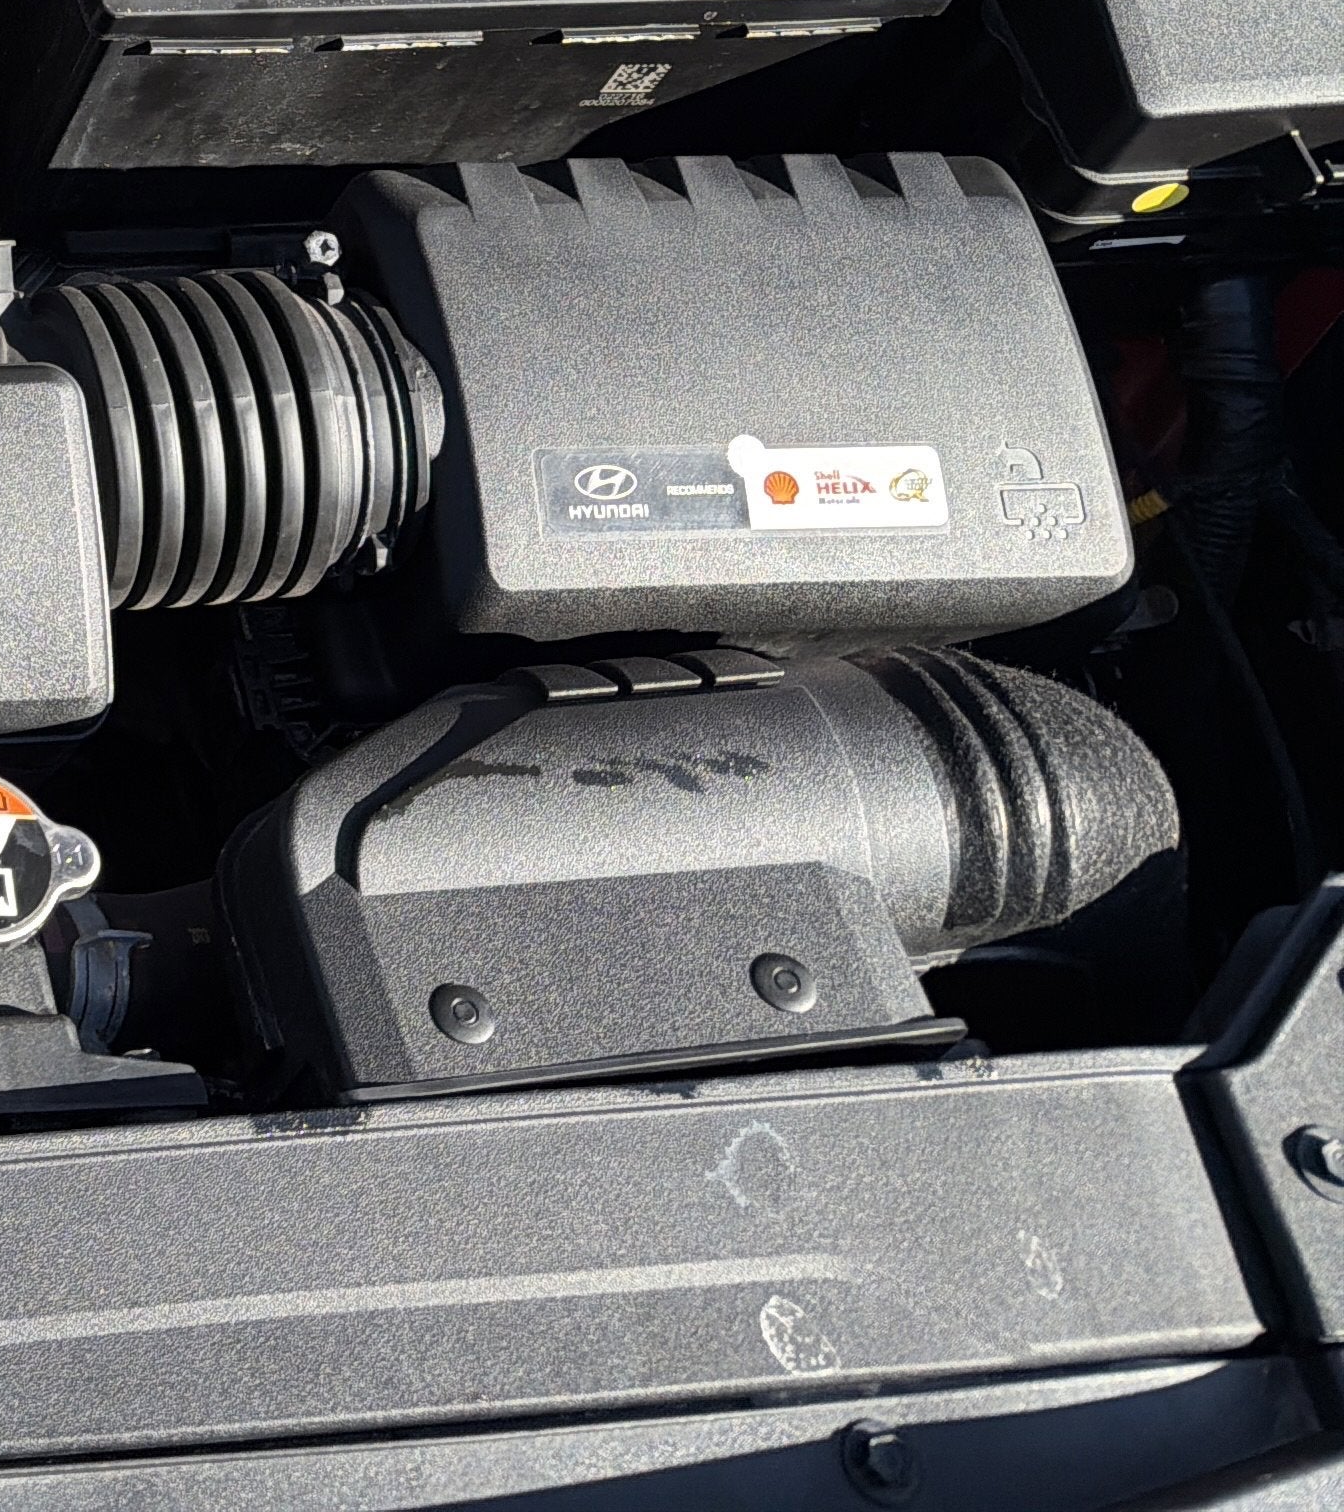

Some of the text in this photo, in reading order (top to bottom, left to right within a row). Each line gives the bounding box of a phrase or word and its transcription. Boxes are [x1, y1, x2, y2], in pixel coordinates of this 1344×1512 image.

[814, 470, 840, 481] Shell
[666, 483, 735, 496] RECOMMENDS
[816, 481, 876, 496] HELIX
[568, 503, 650, 520] HYUNDAI
